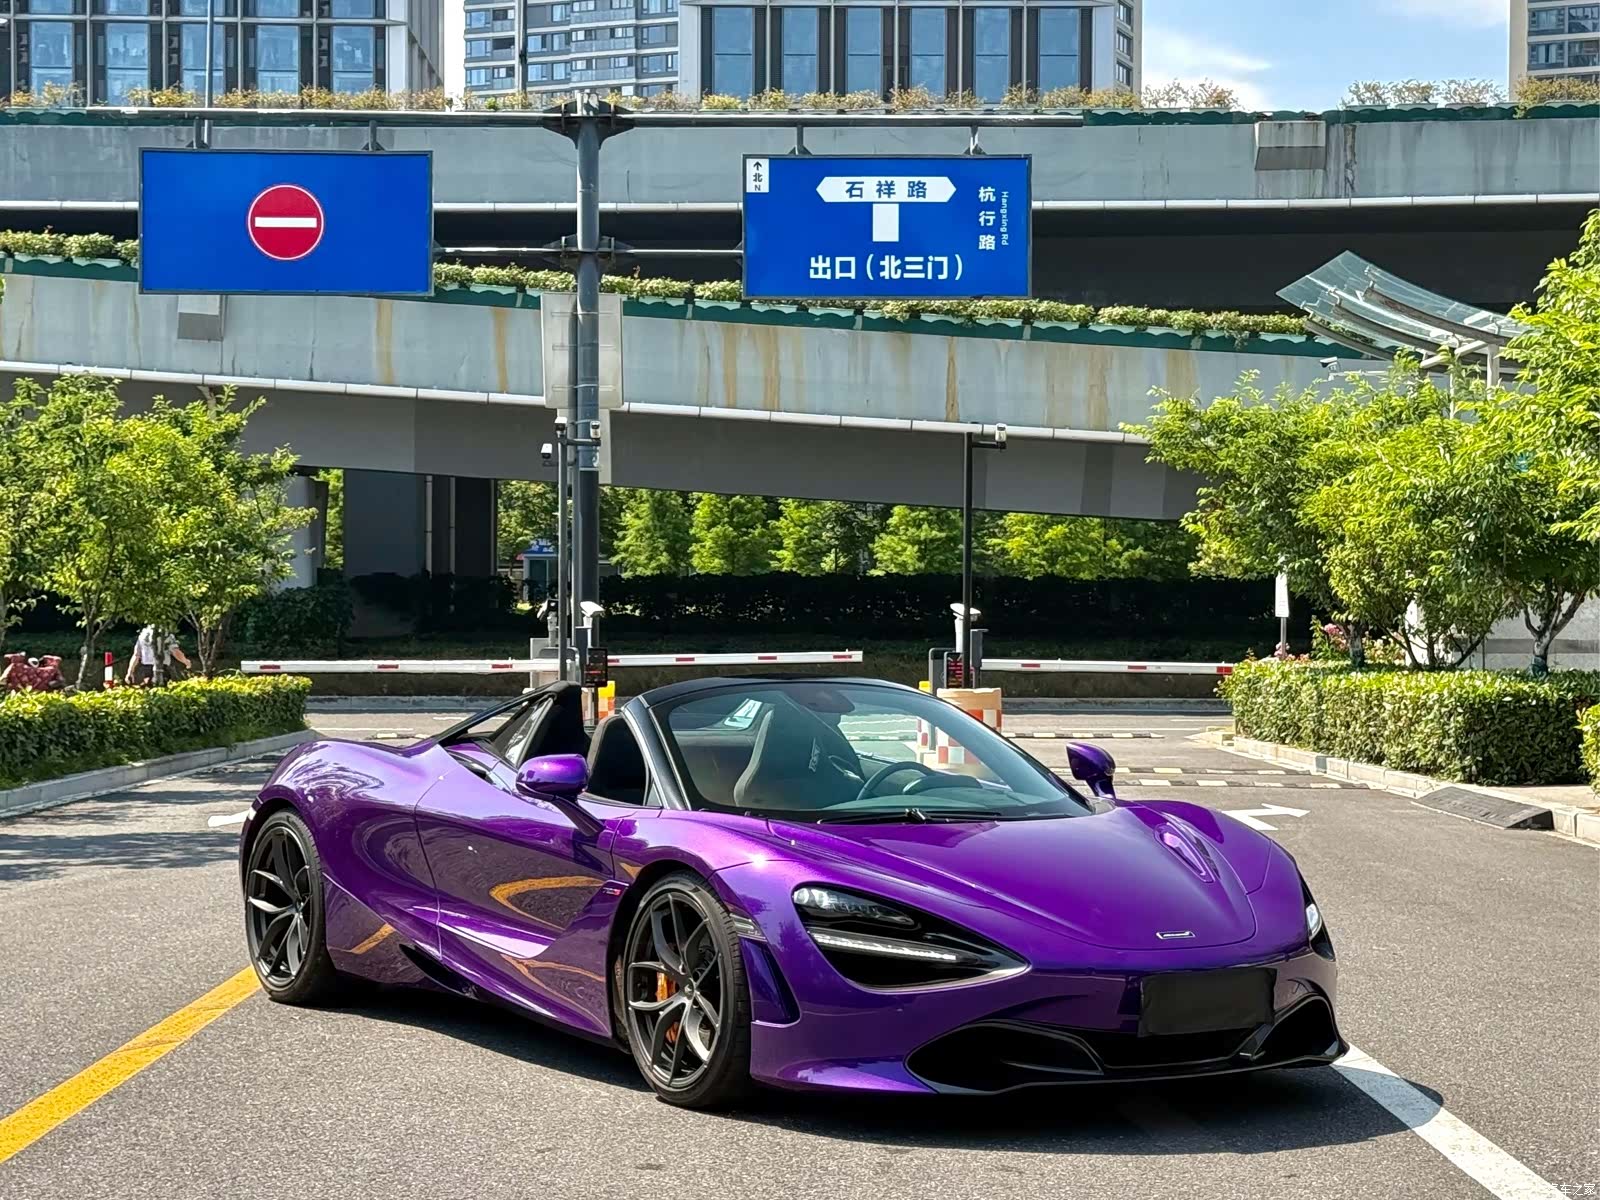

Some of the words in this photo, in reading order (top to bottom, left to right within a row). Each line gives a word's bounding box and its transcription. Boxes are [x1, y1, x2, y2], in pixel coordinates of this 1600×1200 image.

[752, 172, 763, 182] 北
[845, 180, 927, 199] 石祥路
[978, 186, 996, 250] 杭行路
[999, 191, 1009, 233] Hangxing
[1001, 233, 1009, 246] Rd
[809, 254, 963, 280] 出口（北三门）
